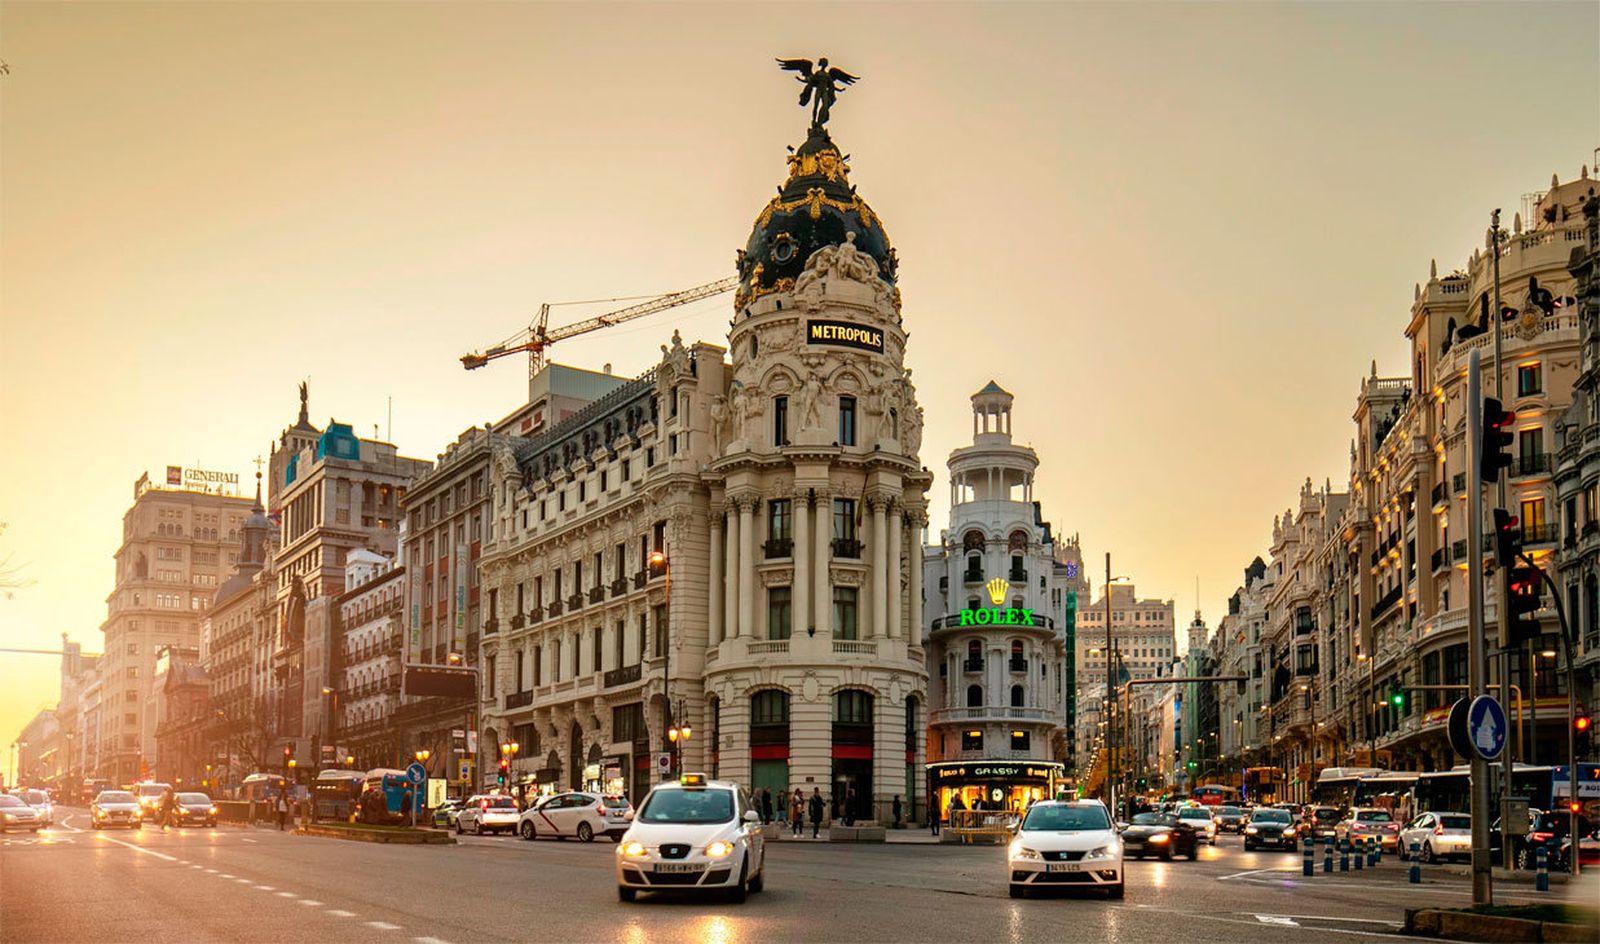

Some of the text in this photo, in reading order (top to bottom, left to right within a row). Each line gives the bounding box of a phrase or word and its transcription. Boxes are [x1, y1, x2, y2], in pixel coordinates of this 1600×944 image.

[812, 325, 882, 347] METROPOLIS
[185, 469, 238, 483] GENERALI
[960, 608, 1034, 626] ROLEX
[975, 767, 1019, 775] GRASSY
